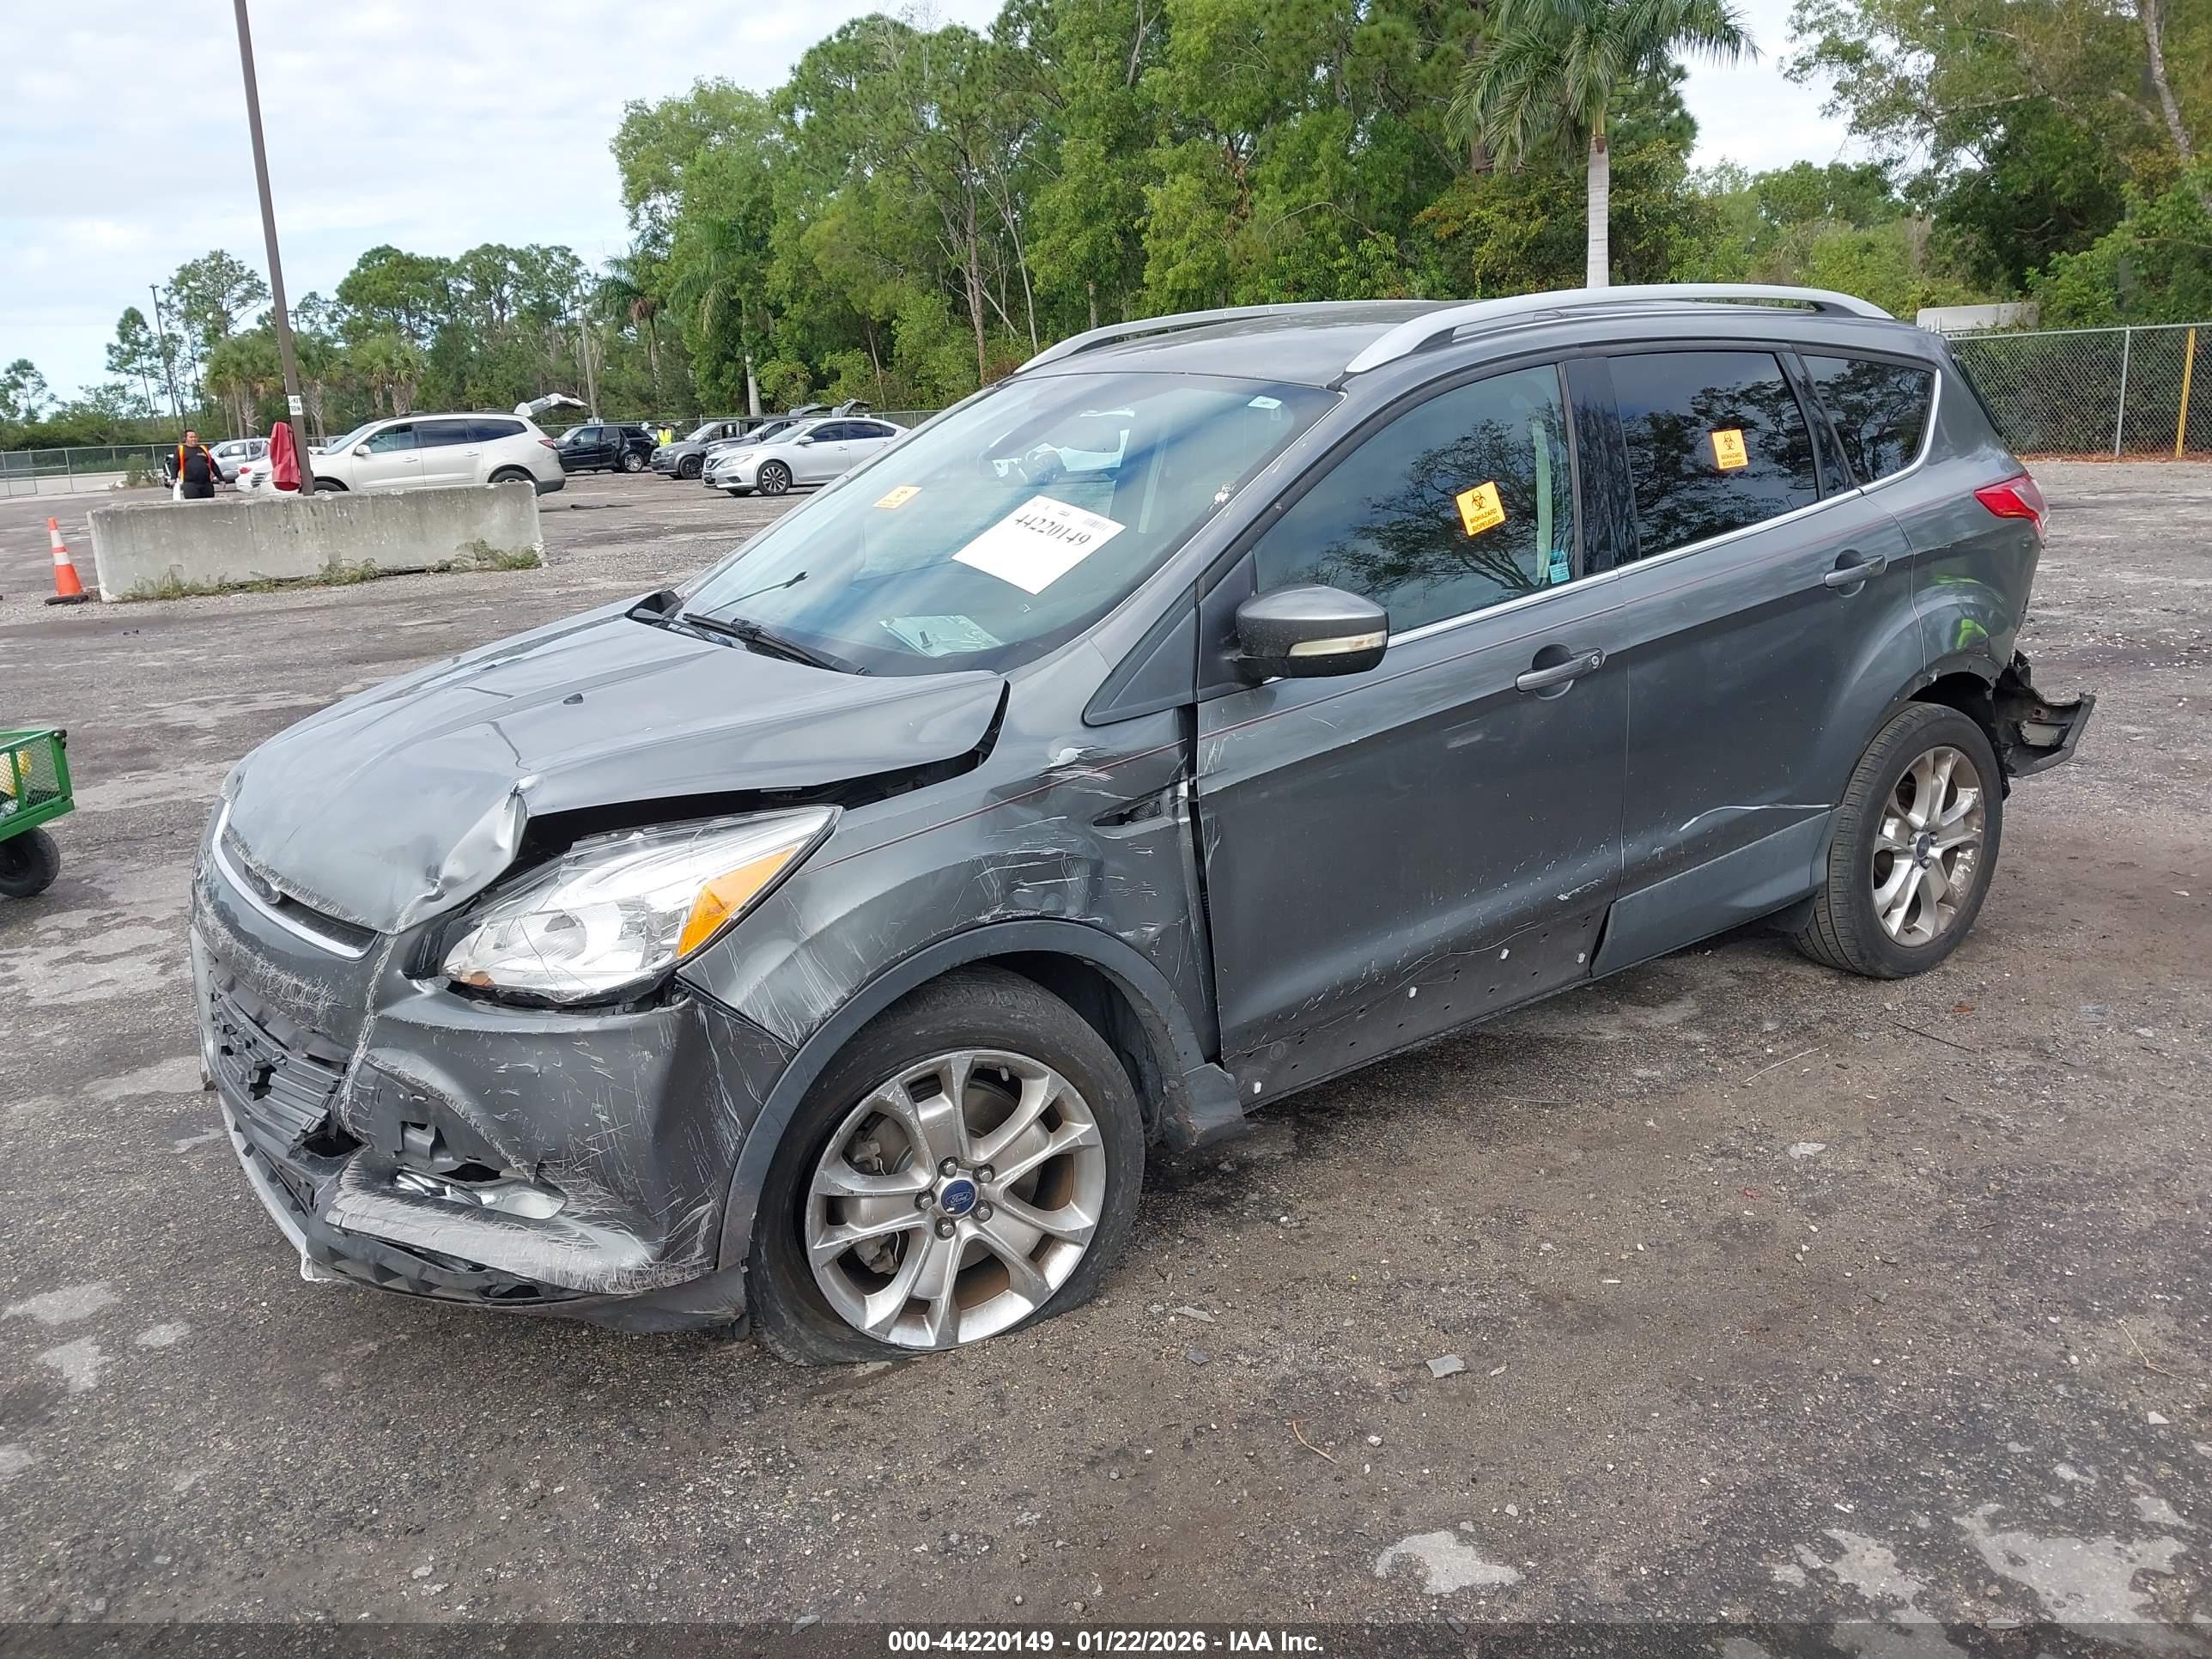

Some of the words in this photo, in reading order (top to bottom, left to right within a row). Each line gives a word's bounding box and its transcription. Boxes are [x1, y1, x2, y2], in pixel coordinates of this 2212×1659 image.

[1469, 507, 1498, 524] BIOHAZARD
[1015, 514, 1091, 546] 44220149
[950, 1193, 969, 1204] Ford
